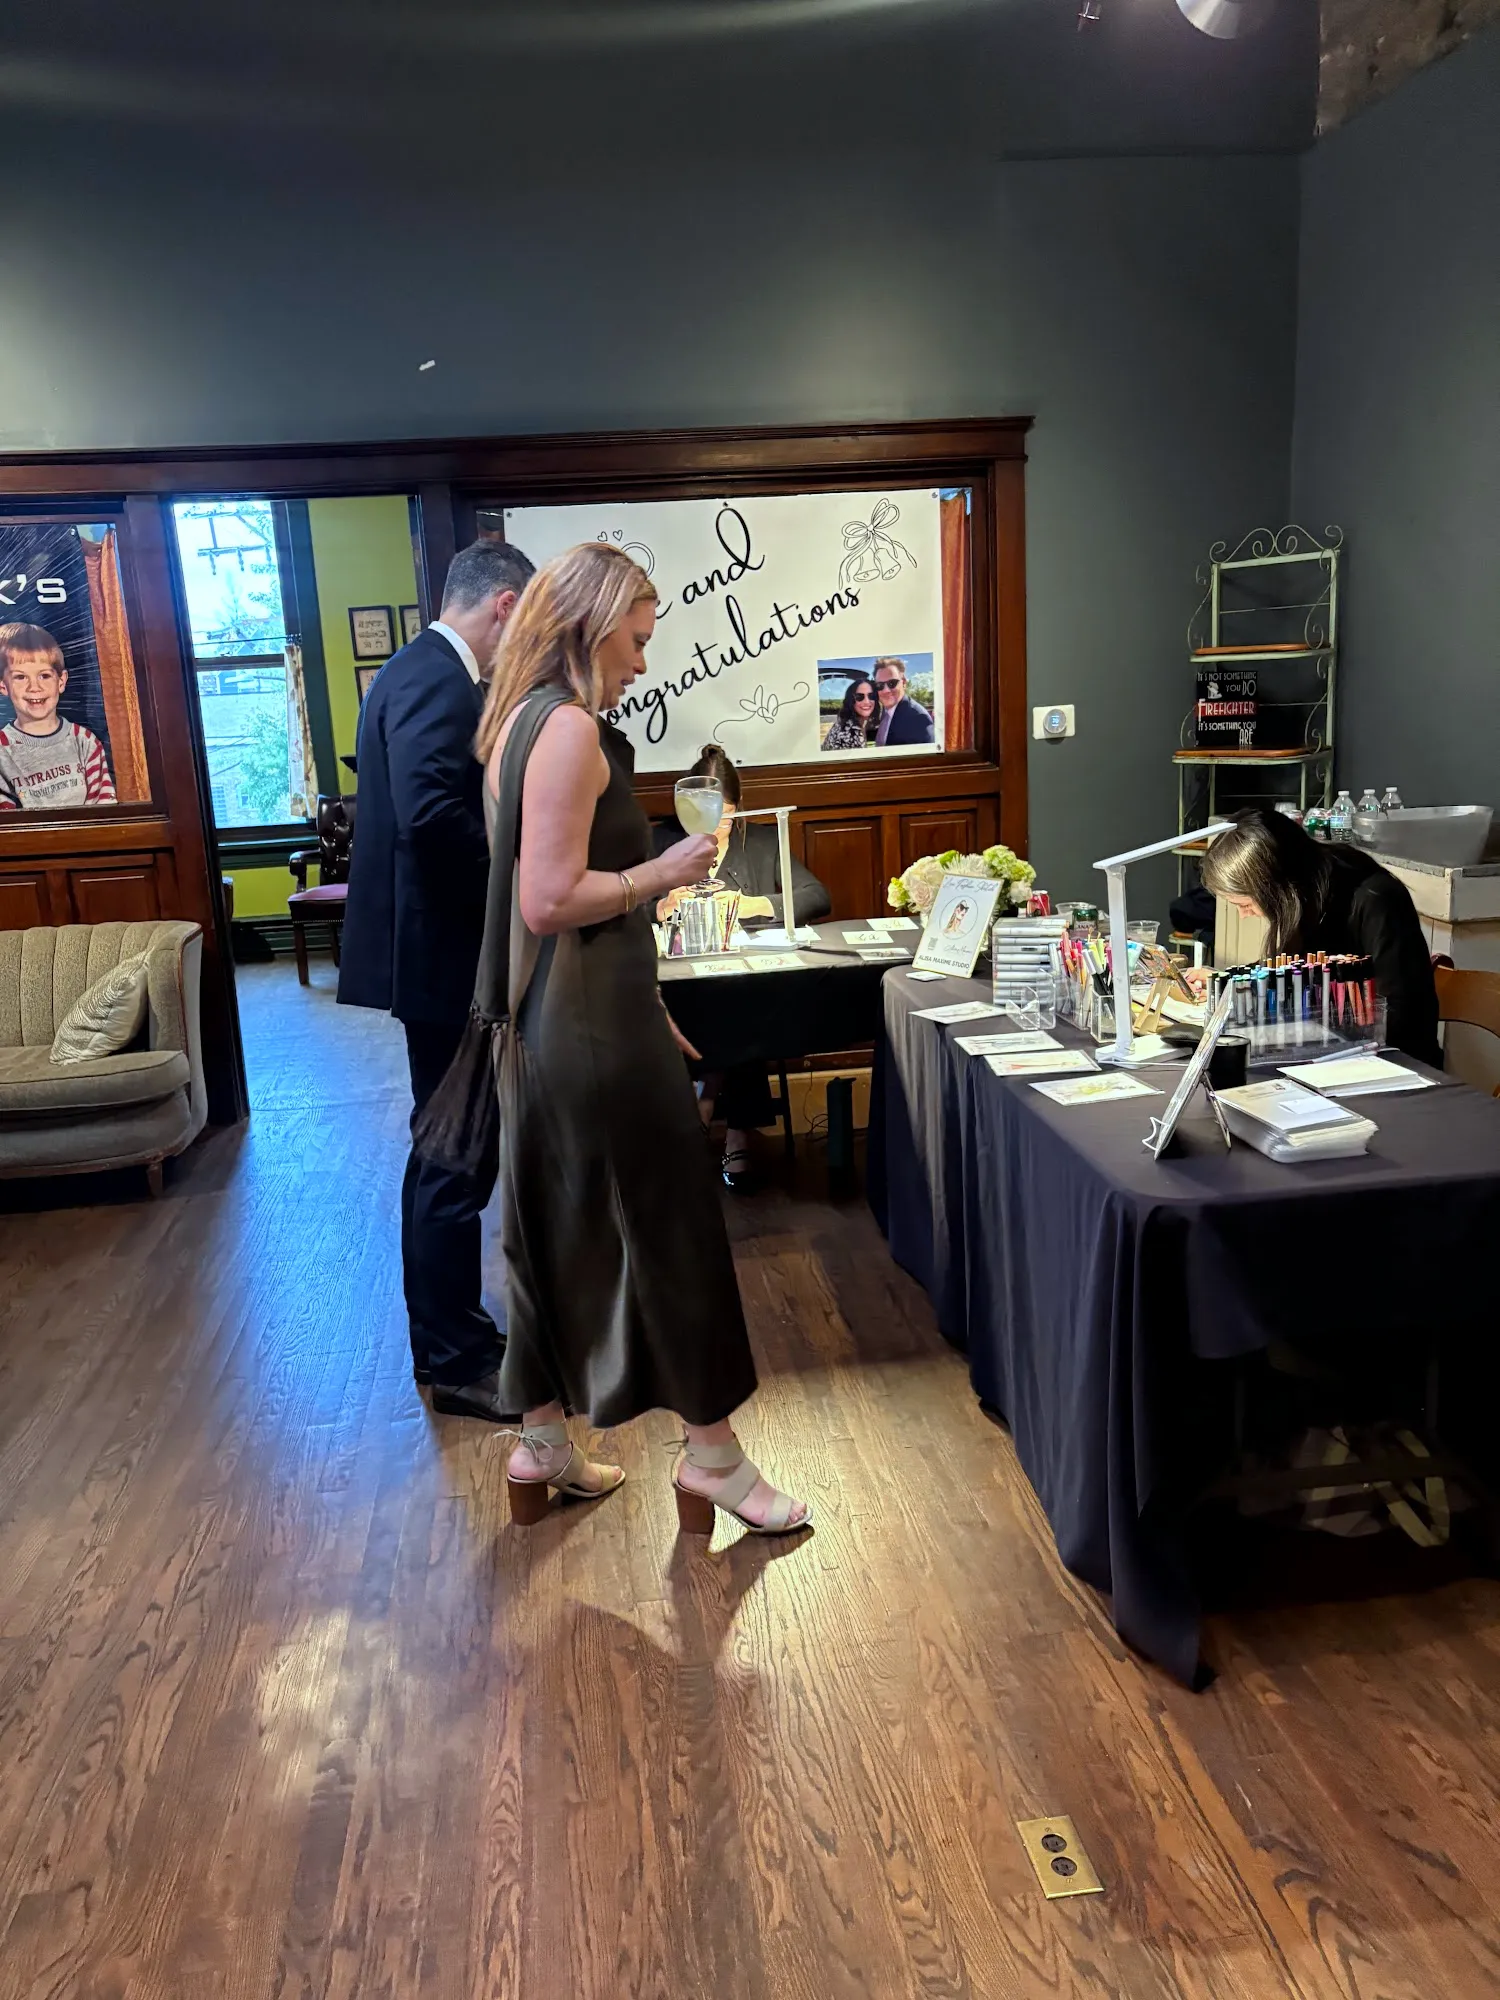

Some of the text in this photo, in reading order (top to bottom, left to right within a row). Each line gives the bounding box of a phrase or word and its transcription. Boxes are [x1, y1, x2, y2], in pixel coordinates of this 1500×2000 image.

[682, 506, 765, 606] and
[606, 585, 862, 744] ongratulations
[1209, 672, 1222, 681] NOT
[1223, 671, 1257, 680] SOMETHING
[1225, 680, 1257, 696] YOU DO
[1198, 698, 1255, 722] FIREFIGHTER
[1209, 721, 1242, 731] SOMETHING
[1242, 721, 1257, 730] YOU
[1239, 728, 1253, 745] ARE
[24, 764, 71, 787] STRAUSS
[932, 957, 952, 966] MAXIME
[952, 960, 970, 969] STUDIO
